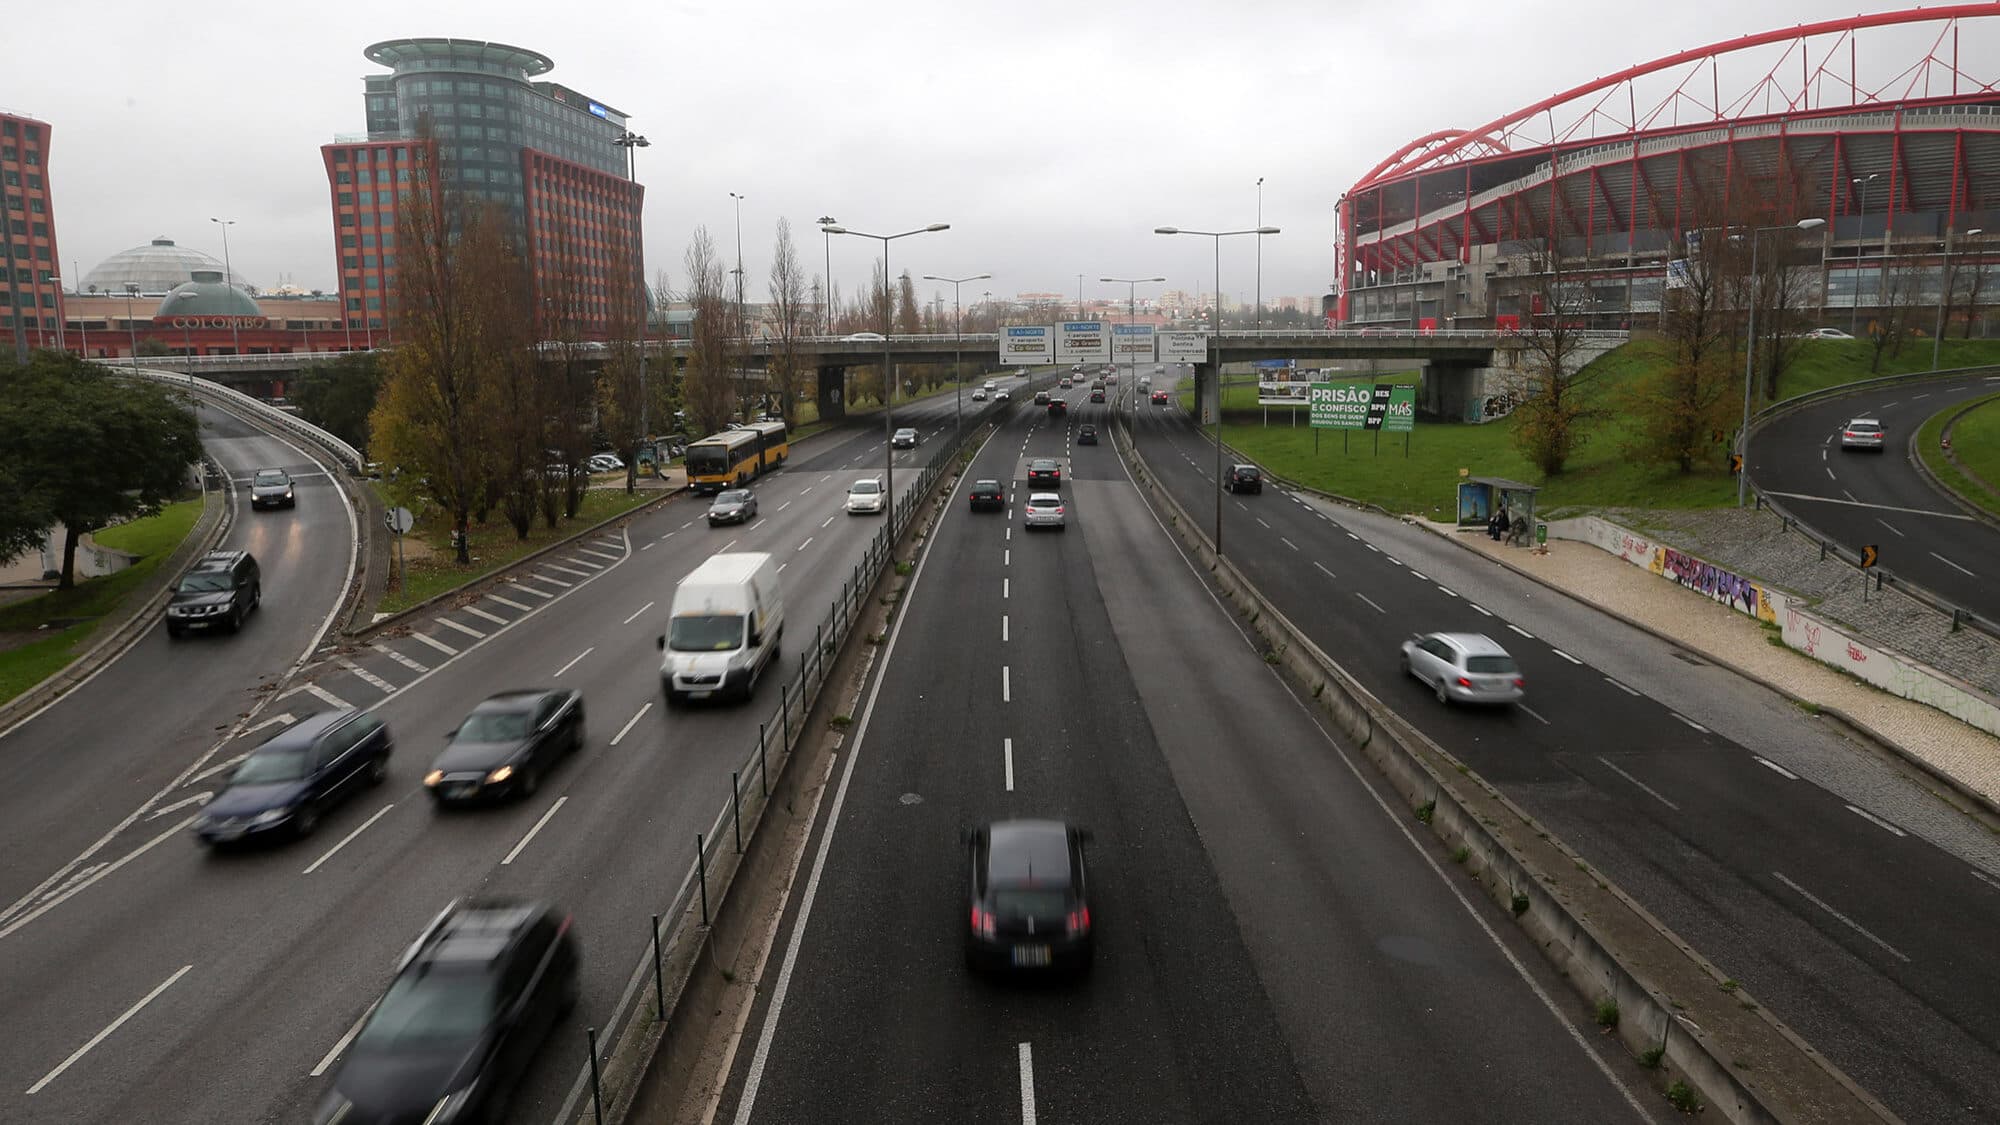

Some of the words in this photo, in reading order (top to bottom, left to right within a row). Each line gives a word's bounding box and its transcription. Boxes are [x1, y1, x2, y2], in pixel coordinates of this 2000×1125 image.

[172, 316, 265, 329] COLOMBO
[1312, 386, 1370, 403] PRISÃO
[1312, 403, 1318, 411] E
[1319, 403, 1367, 413] CONFISCO
[1371, 403, 1386, 411] BPN
[1367, 416, 1382, 425] BPP
